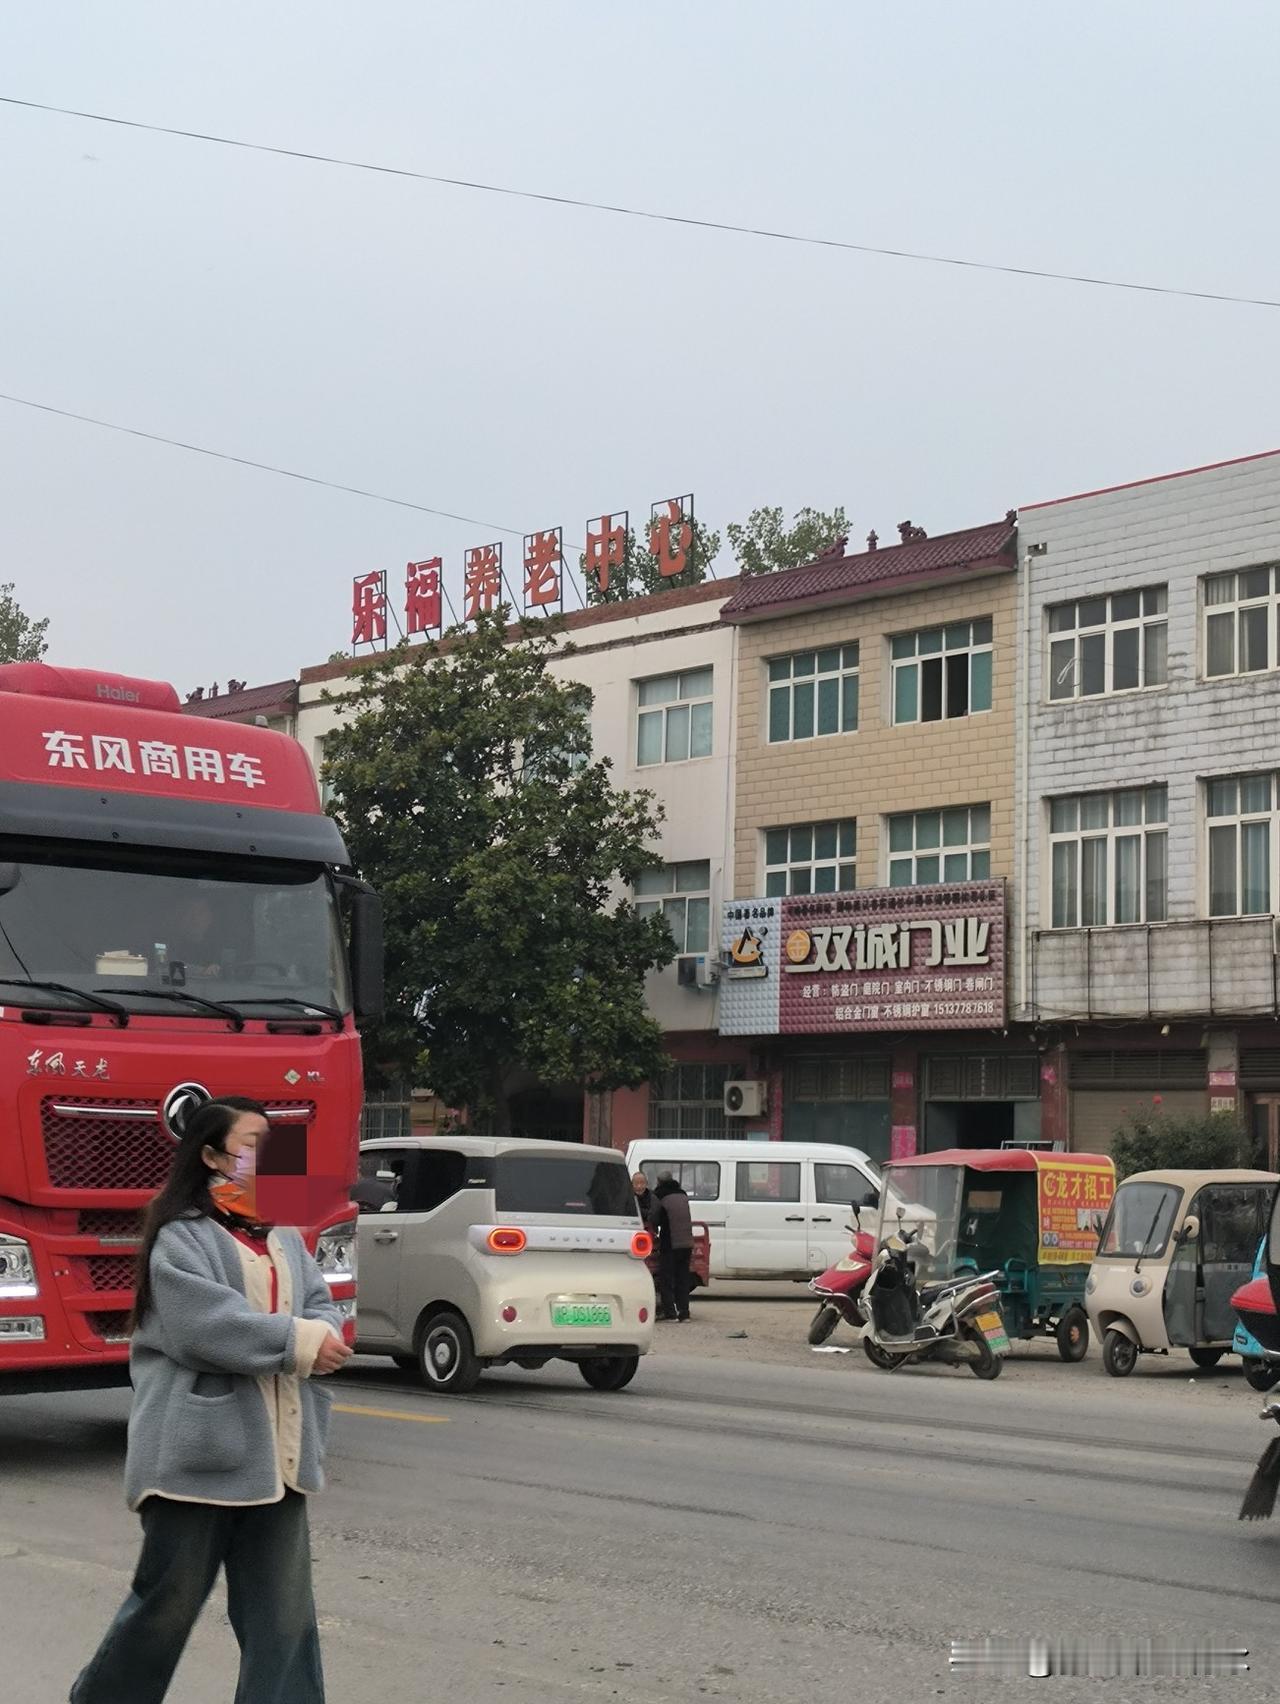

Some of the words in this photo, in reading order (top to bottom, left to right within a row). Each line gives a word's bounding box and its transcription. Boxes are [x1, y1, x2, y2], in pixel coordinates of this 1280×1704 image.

[351, 499, 694, 644] 乐福养老中心
[95, 683, 141, 703] Haier
[41, 730, 267, 789] 东风商用车
[785, 916, 991, 973] 双诚门业
[894, 979, 920, 995] 室内门
[924, 978, 961, 993] 不锈钢门
[834, 1005, 879, 1021] 铝合金门窗
[883, 1003, 930, 1018] 不锈钢护窗
